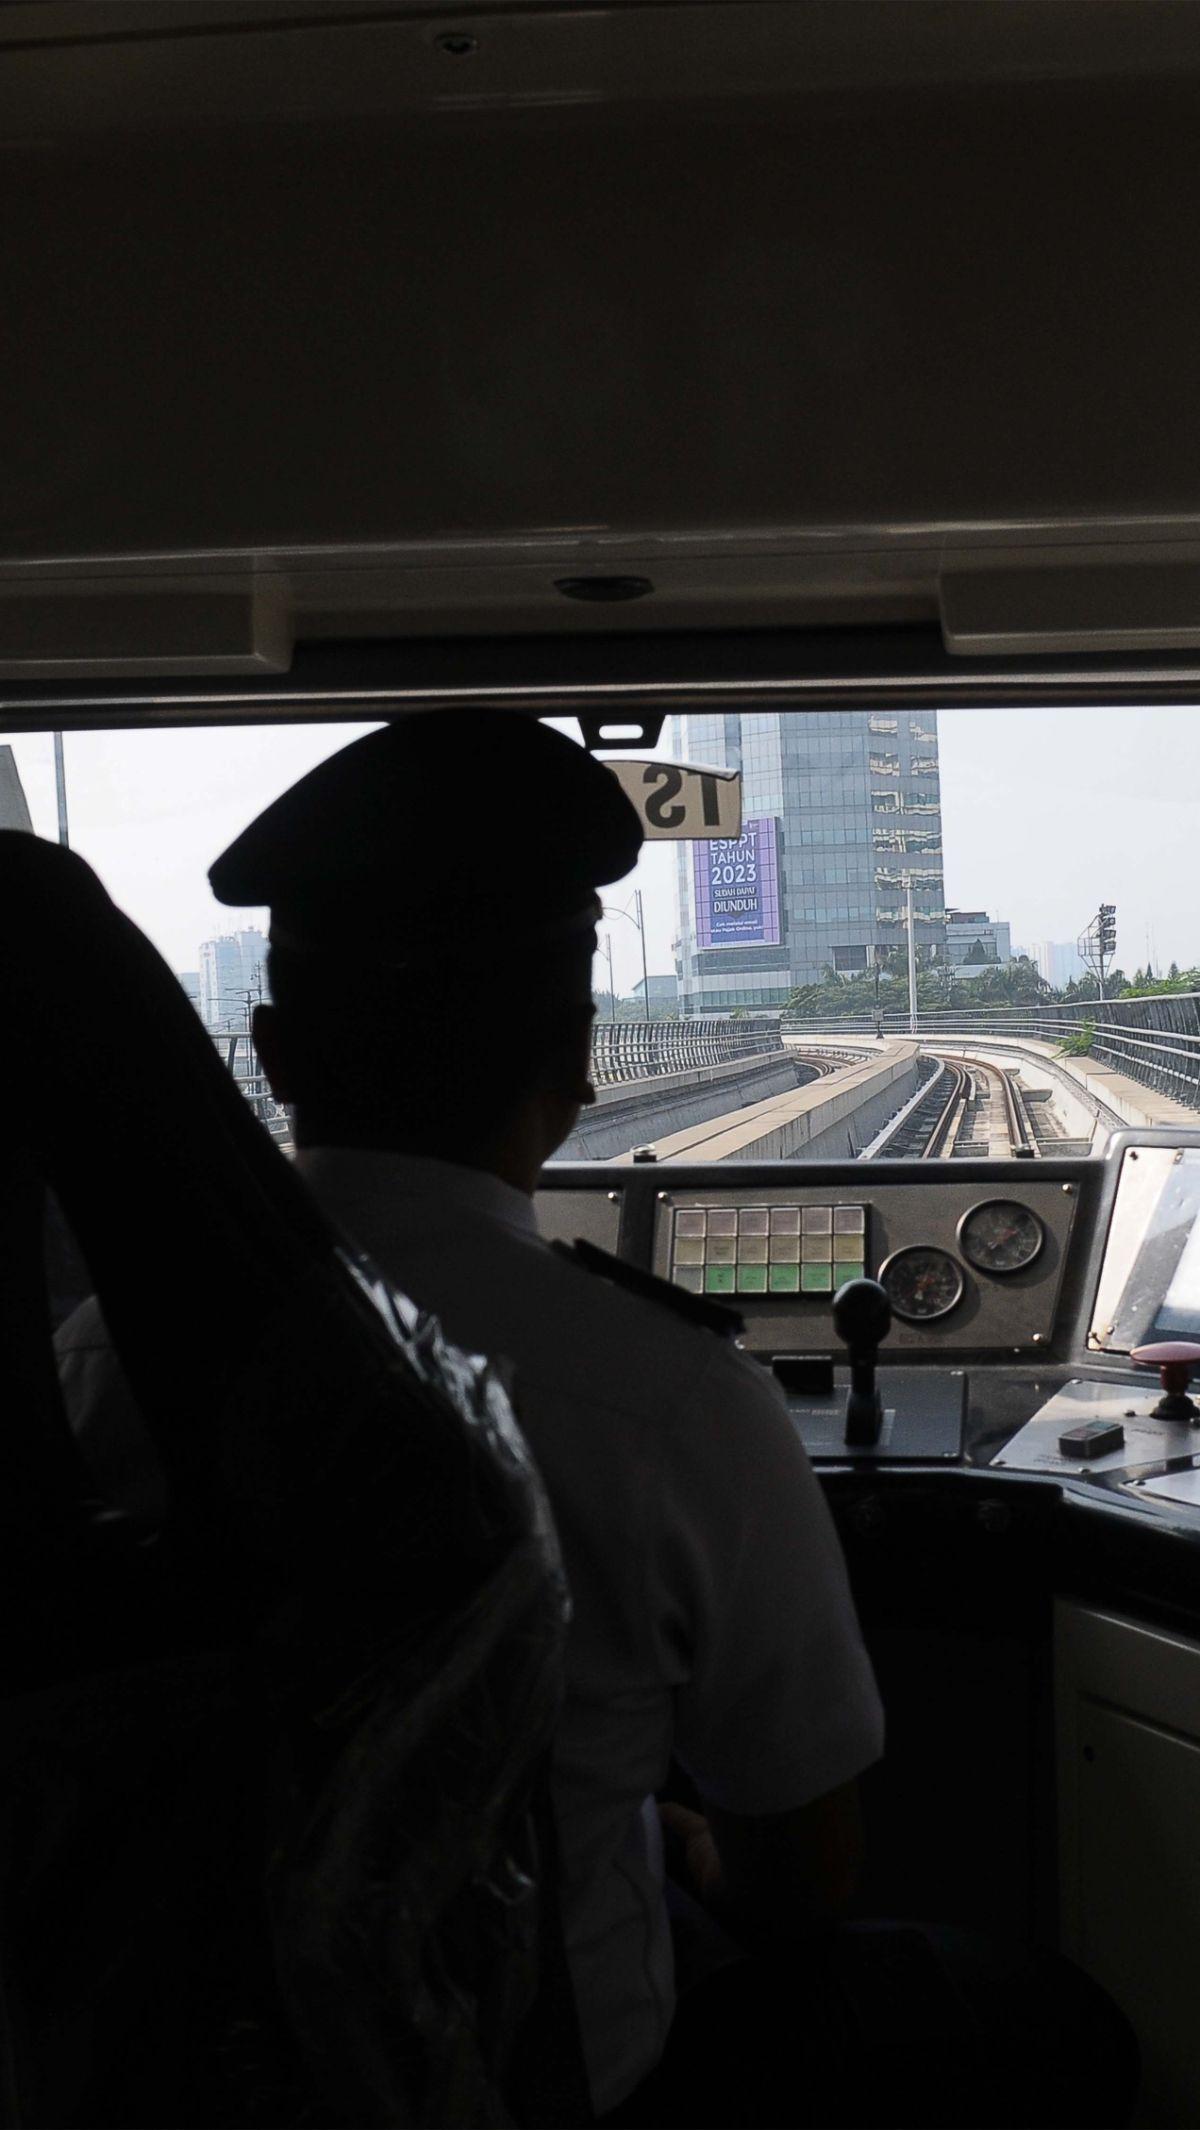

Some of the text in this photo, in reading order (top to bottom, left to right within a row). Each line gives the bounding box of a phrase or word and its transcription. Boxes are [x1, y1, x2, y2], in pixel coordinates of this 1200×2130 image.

[710, 849, 755, 865] TAHUN
[711, 863, 757, 885] 2023
[713, 898, 757, 913] DIUNDUH
